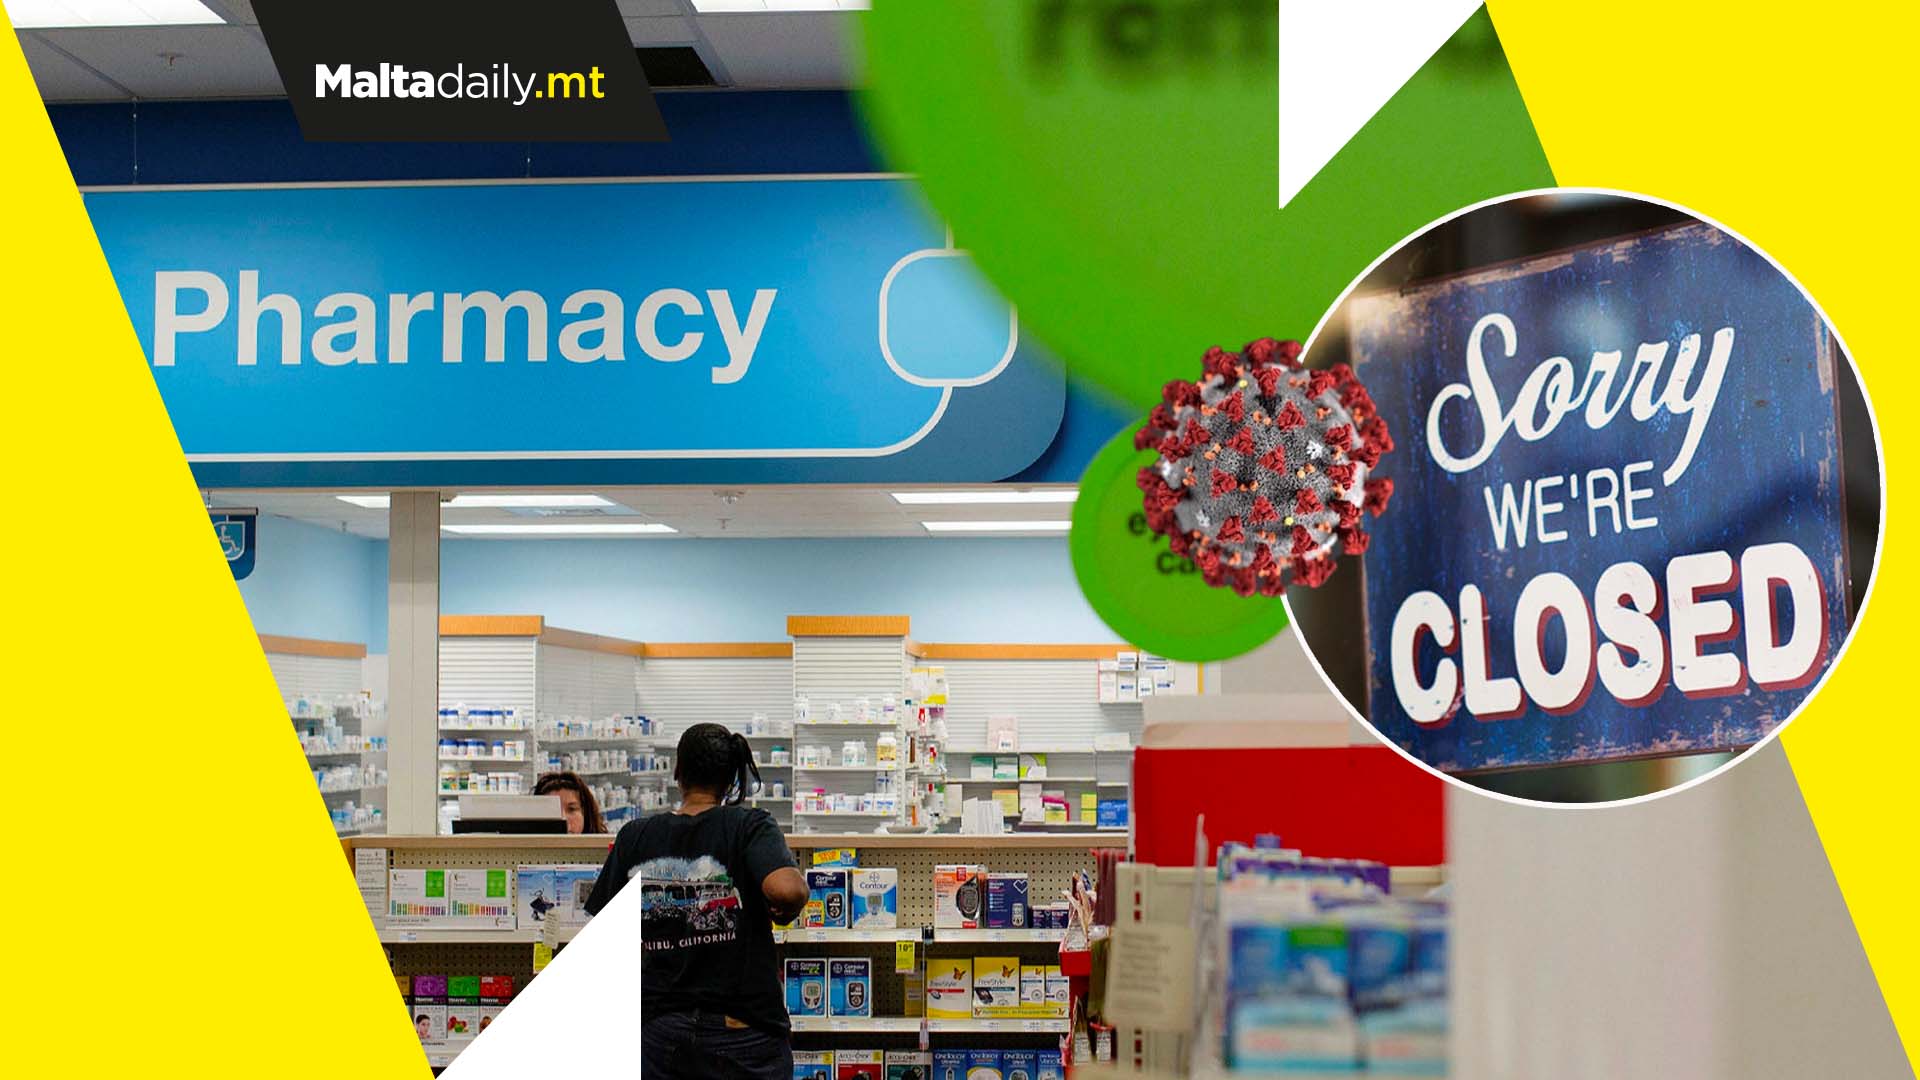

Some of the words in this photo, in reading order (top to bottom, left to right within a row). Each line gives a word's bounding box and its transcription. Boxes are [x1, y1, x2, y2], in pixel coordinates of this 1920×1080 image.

[153, 269, 778, 385] Pharmacy
[1427, 313, 1735, 486] Sorry
[1485, 460, 1658, 550] WE'RE
[1391, 542, 1827, 726] CLOSED
